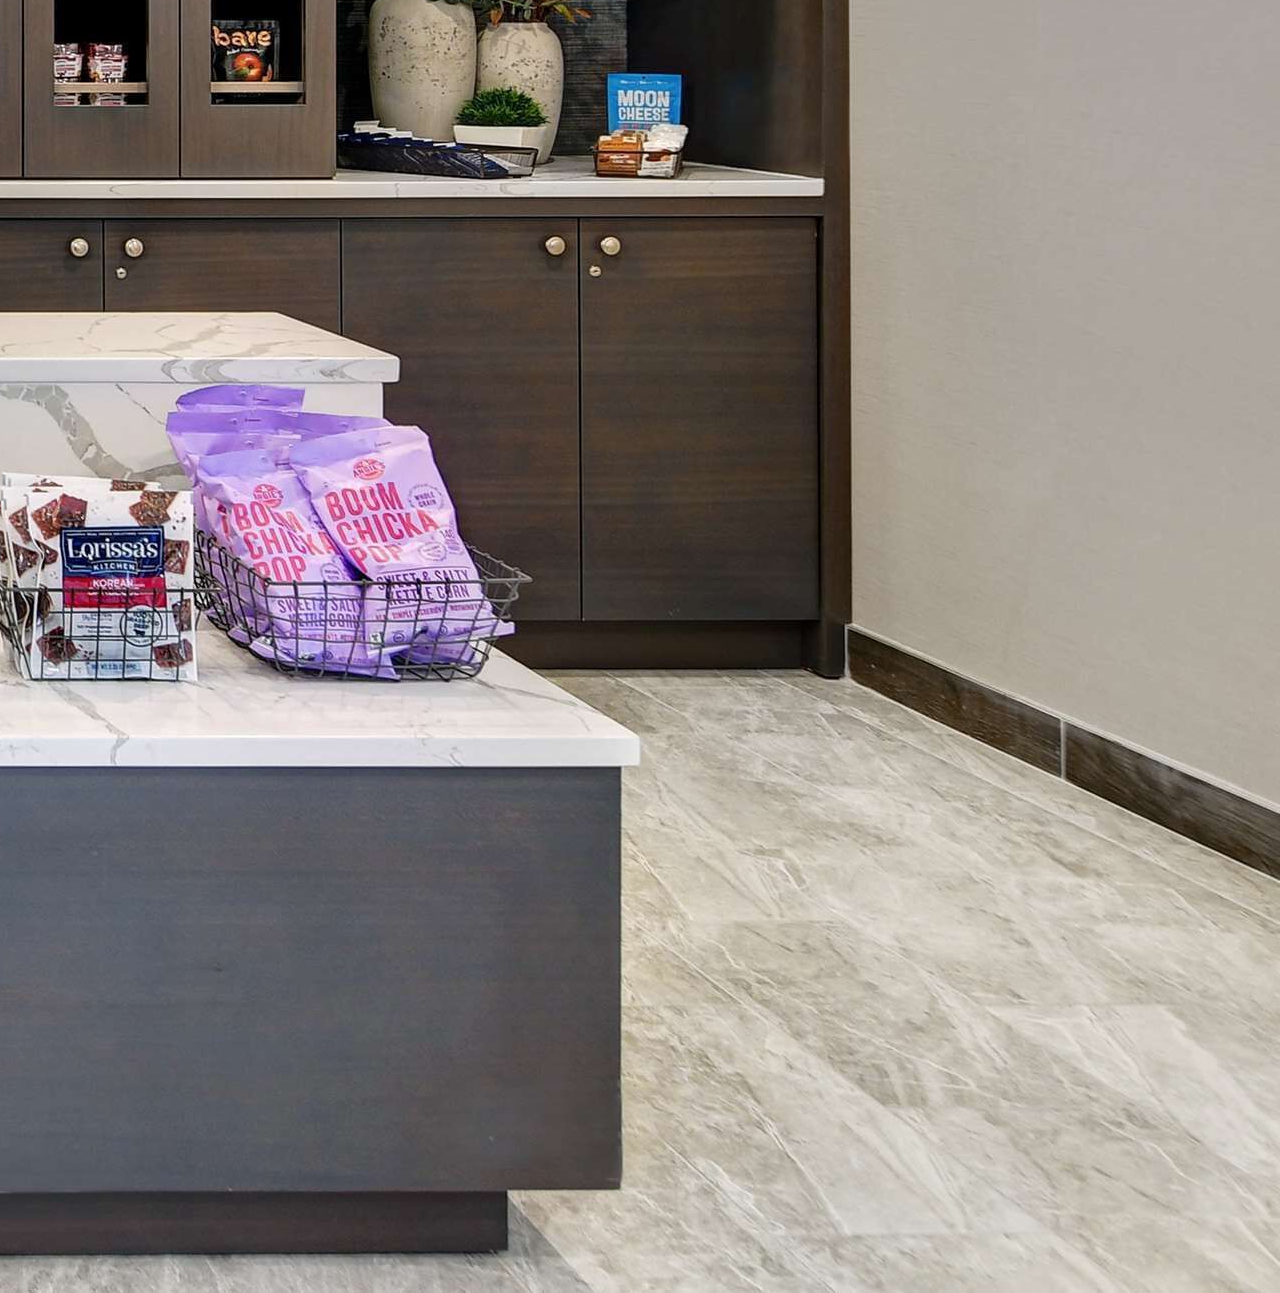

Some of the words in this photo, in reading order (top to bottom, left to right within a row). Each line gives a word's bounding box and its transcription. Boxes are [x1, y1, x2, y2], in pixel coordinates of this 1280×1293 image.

[212, 25, 272, 46] bare
[617, 90, 670, 107] MOON
[618, 107, 670, 121] CHEESE
[336, 509, 439, 546] CHICKA
[67, 536, 160, 561] Lorissa's
[93, 562, 136, 571] KITCHEN
[92, 578, 135, 588] KOREAN
[389, 588, 433, 605] ETTE
